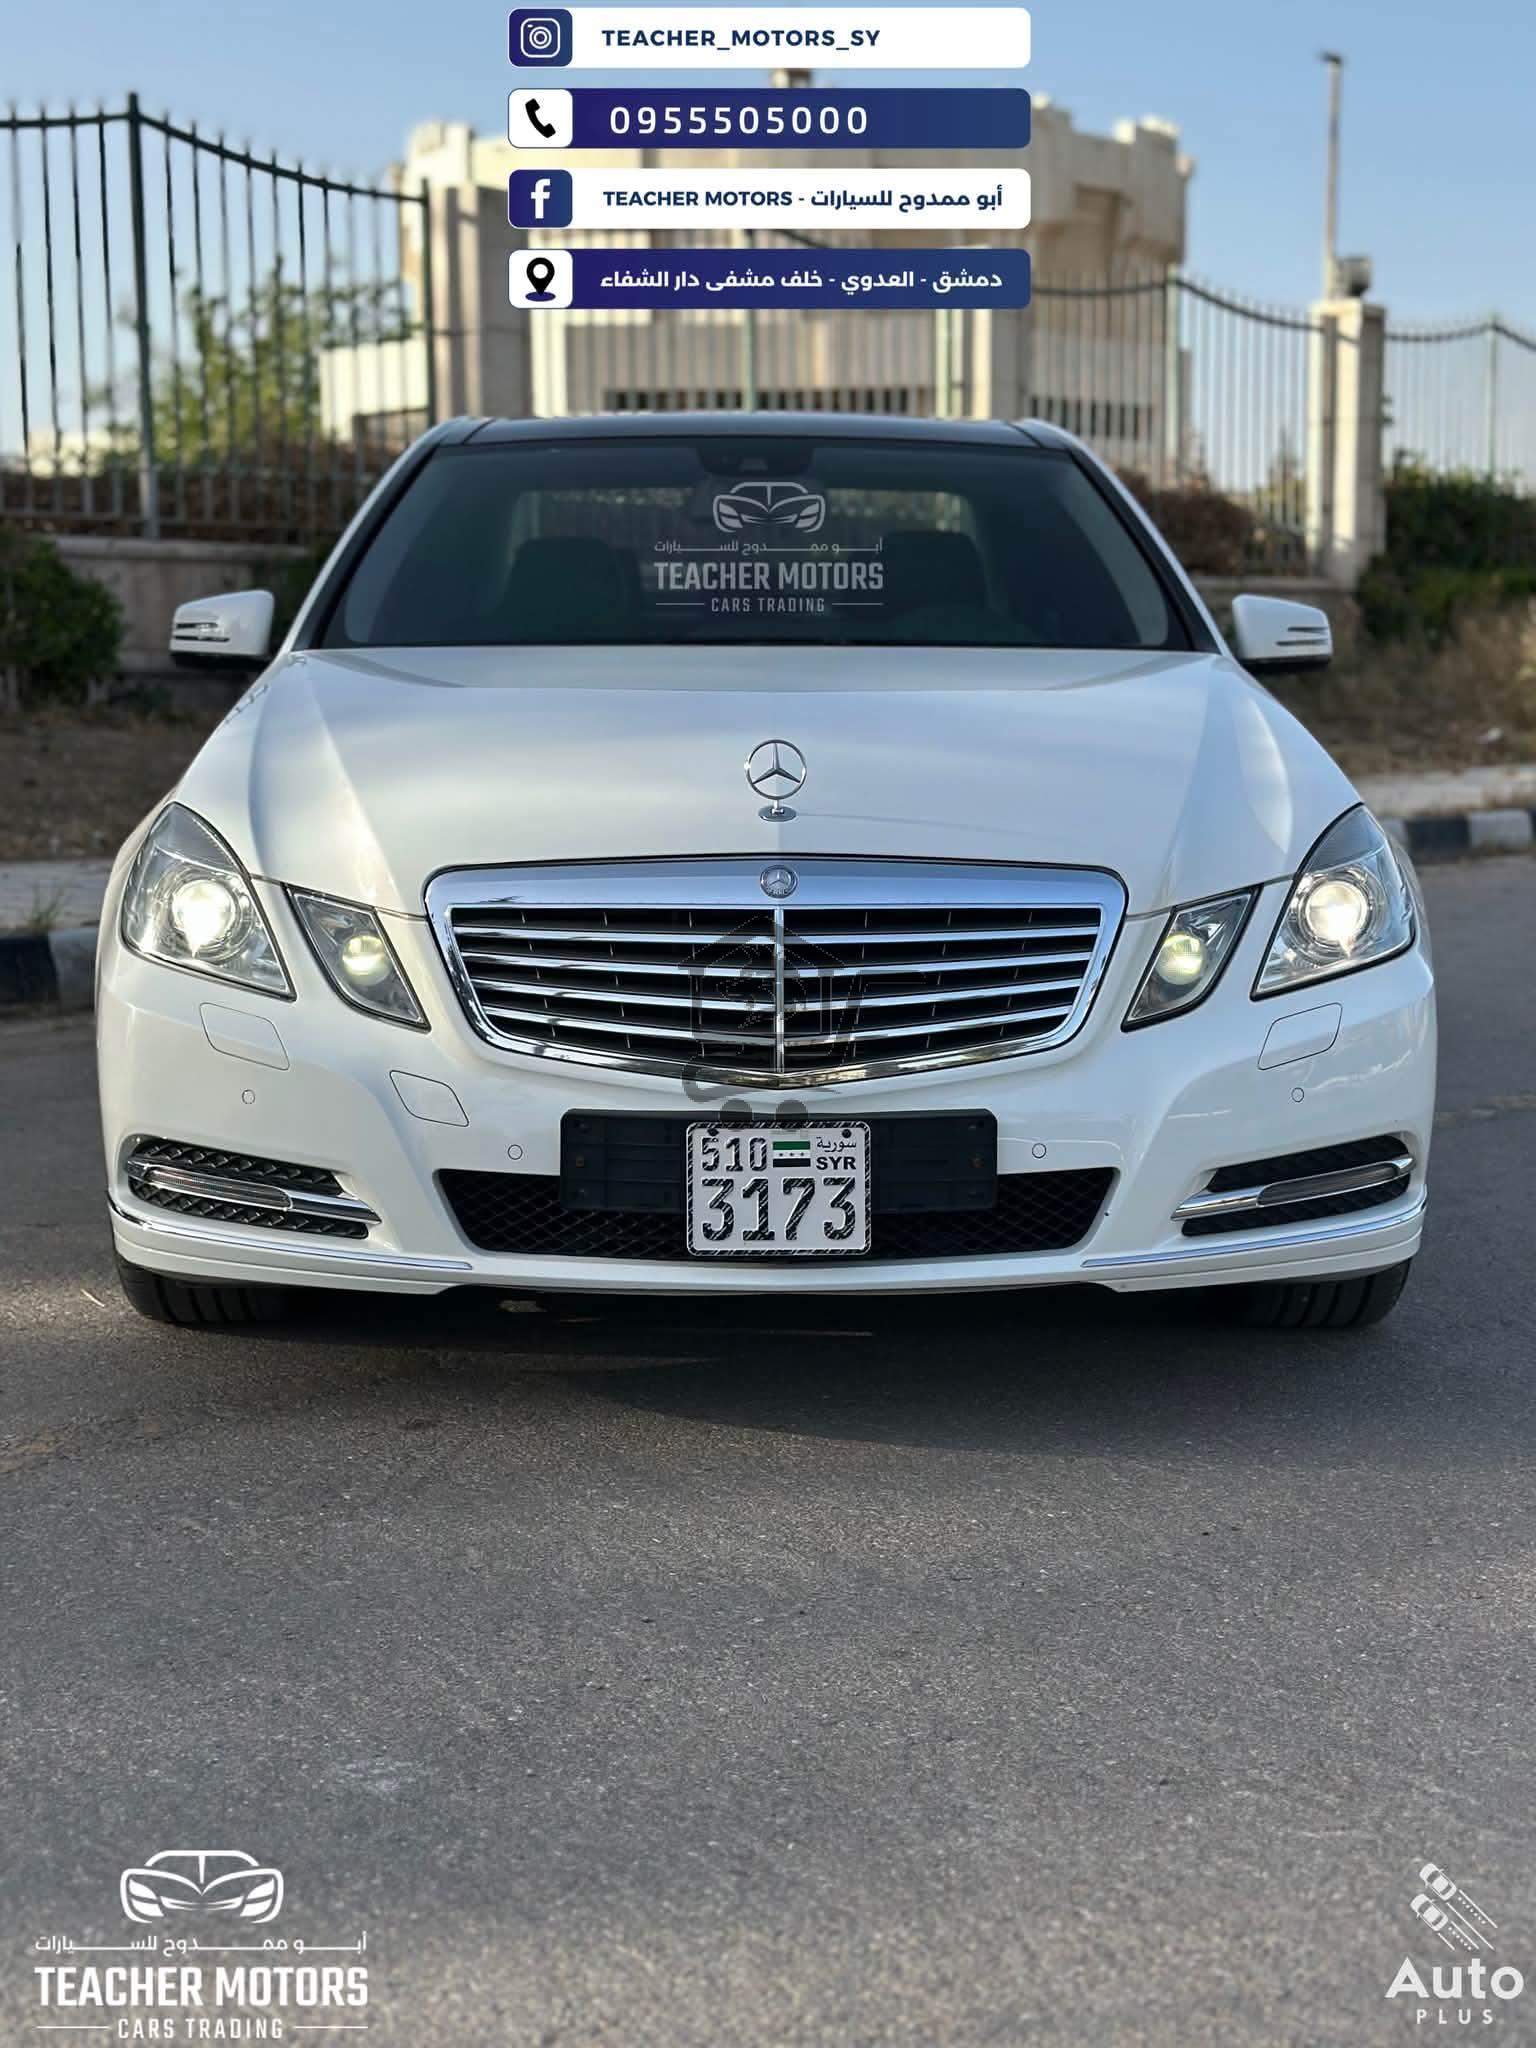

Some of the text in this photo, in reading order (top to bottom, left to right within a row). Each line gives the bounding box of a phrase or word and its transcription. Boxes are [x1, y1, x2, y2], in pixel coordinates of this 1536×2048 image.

[701, 1137, 768, 1172] 510
[816, 1136, 857, 1153] سورية
[816, 1156, 857, 1171] SYR
[702, 1177, 856, 1241] 3173
